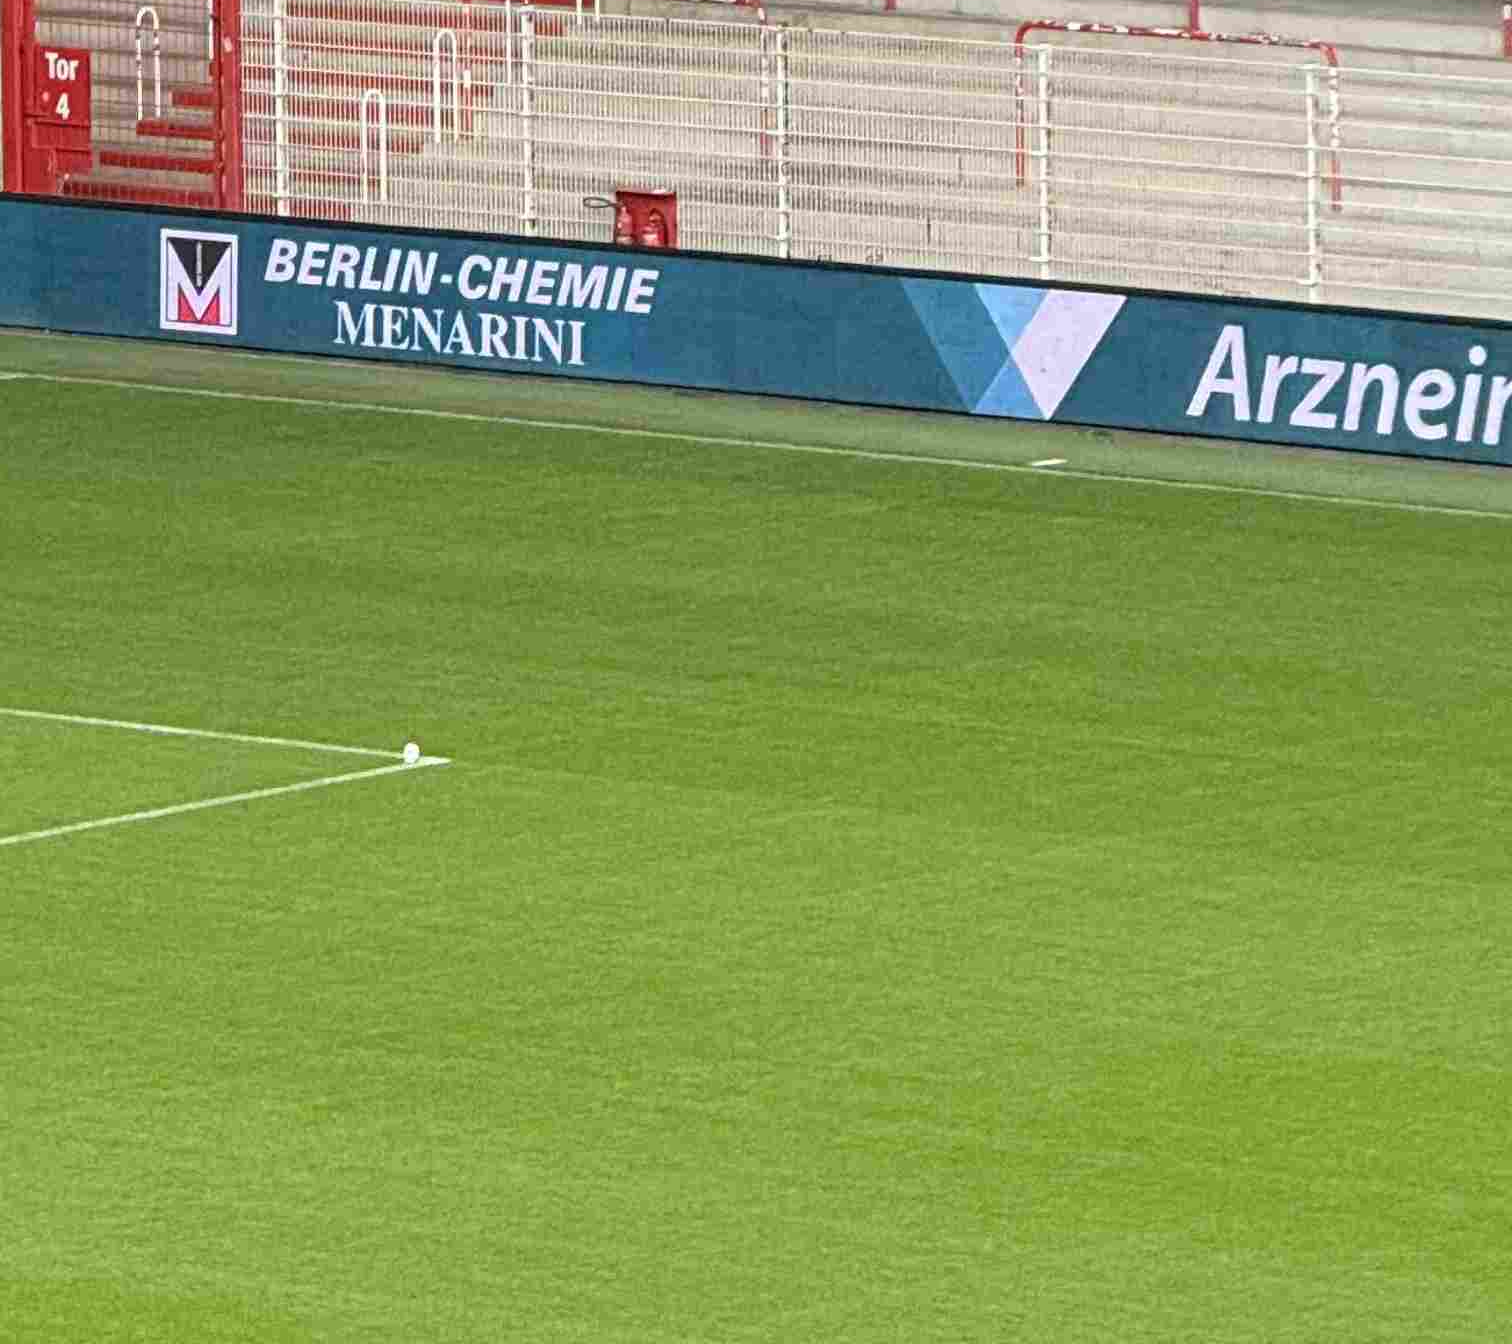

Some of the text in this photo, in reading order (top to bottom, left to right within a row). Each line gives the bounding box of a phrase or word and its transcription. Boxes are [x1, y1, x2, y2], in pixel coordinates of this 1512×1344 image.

[44, 52, 79, 82] Tor
[55, 93, 71, 120] 4
[264, 238, 659, 314] BERLIN-CHEMIE
[334, 301, 585, 365] MENARINI
